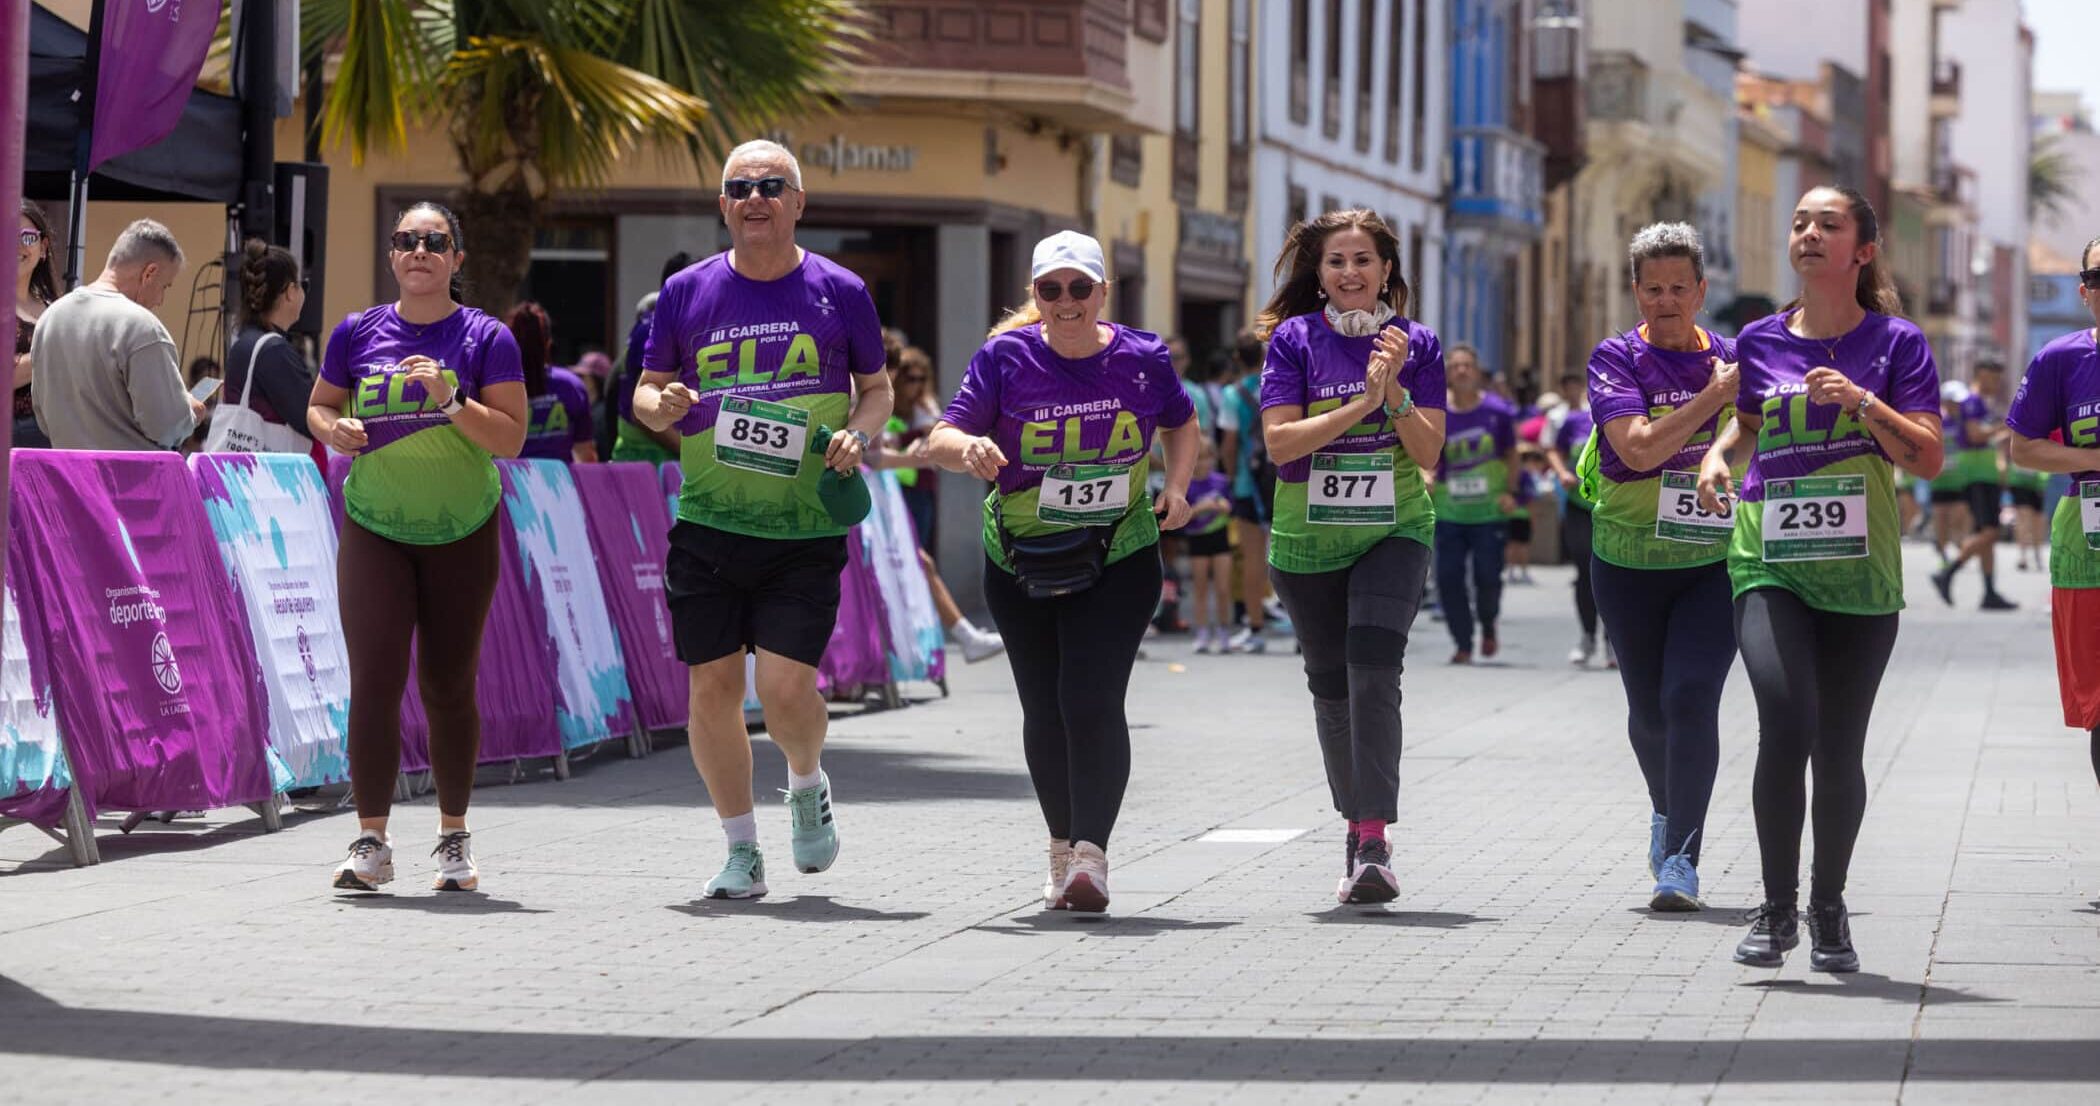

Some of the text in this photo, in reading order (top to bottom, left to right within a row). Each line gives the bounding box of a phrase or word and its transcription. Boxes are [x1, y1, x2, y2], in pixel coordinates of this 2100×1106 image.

[710, 321, 800, 343] III CARRERA
[760, 334, 788, 344] POR LA
[696, 333, 820, 391] ELA
[1321, 386, 1335, 398] III
[1653, 393, 1667, 404] III
[1034, 397, 1122, 421] III CARRERA
[1084, 412, 1112, 422] POR LA
[731, 418, 789, 449] 853
[1757, 394, 1872, 453] ELA
[1020, 410, 1144, 465] ELA
[1058, 480, 1113, 505] 137
[1322, 475, 1378, 498] 877
[1779, 501, 1847, 530] 239
